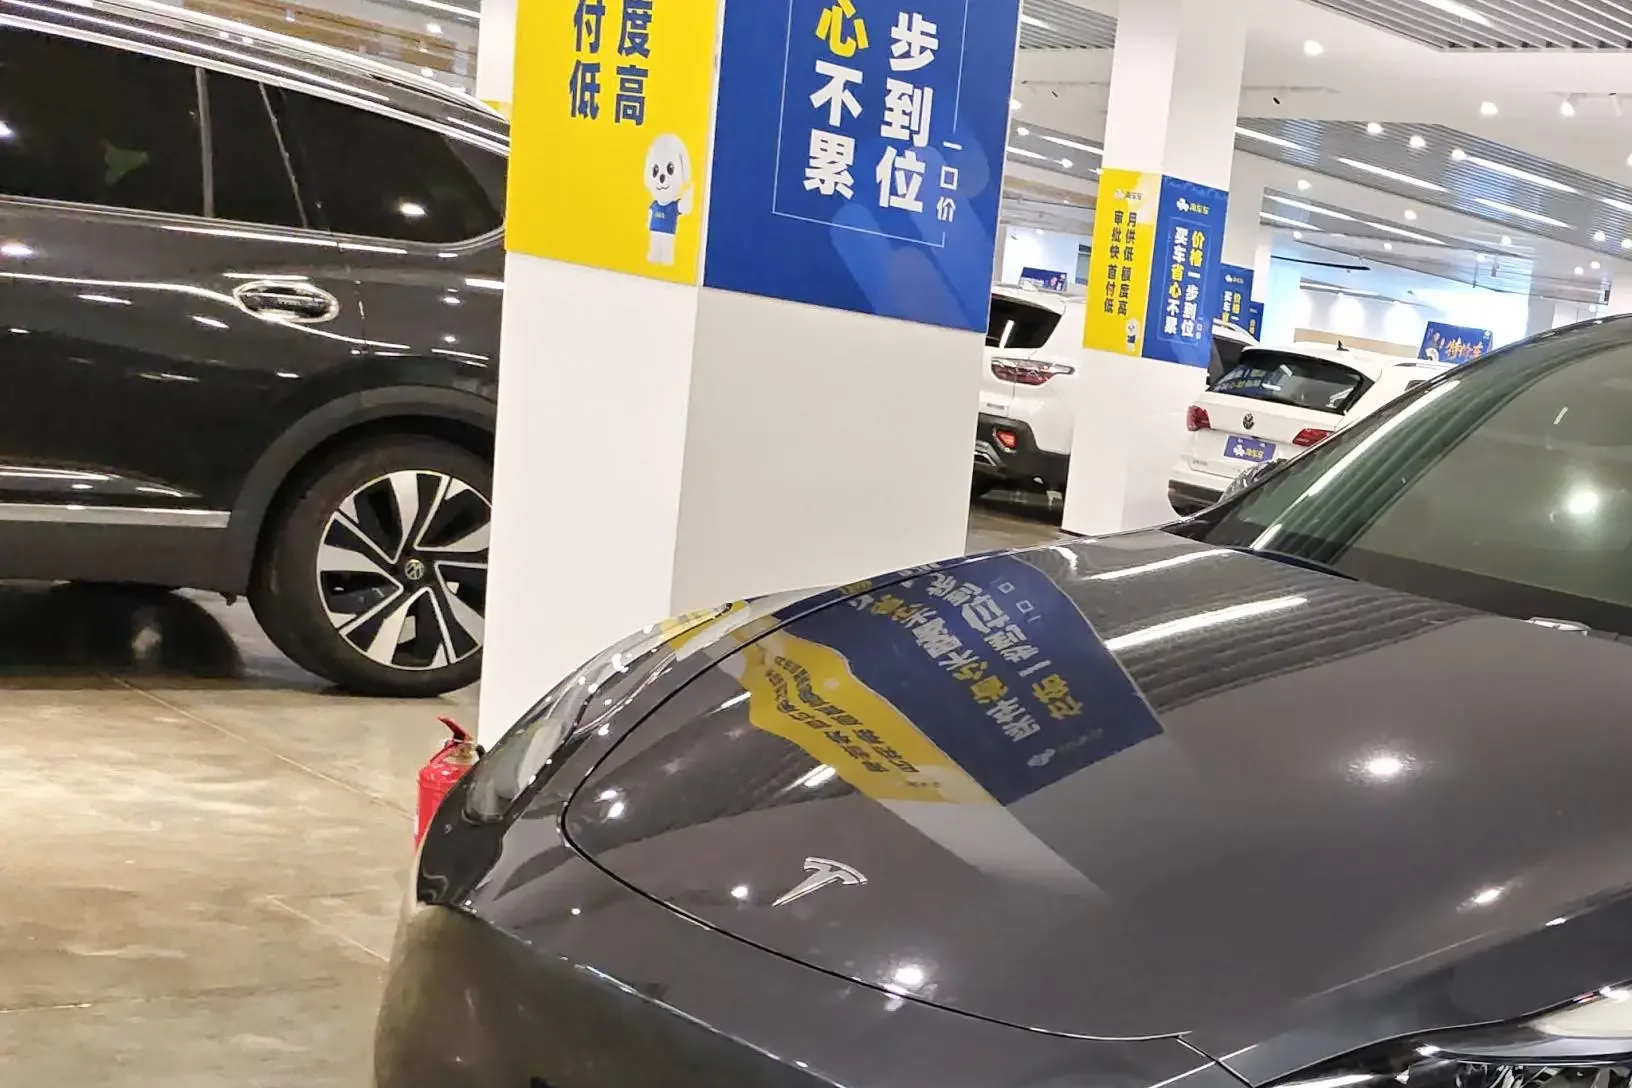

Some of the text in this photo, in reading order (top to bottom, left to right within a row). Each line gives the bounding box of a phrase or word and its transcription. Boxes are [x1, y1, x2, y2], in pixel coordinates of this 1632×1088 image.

[568, 0, 605, 120] 付低
[803, 0, 869, 200] 心不累
[876, 12, 939, 213] 步到位
[936, 141, 963, 222] 一口价
